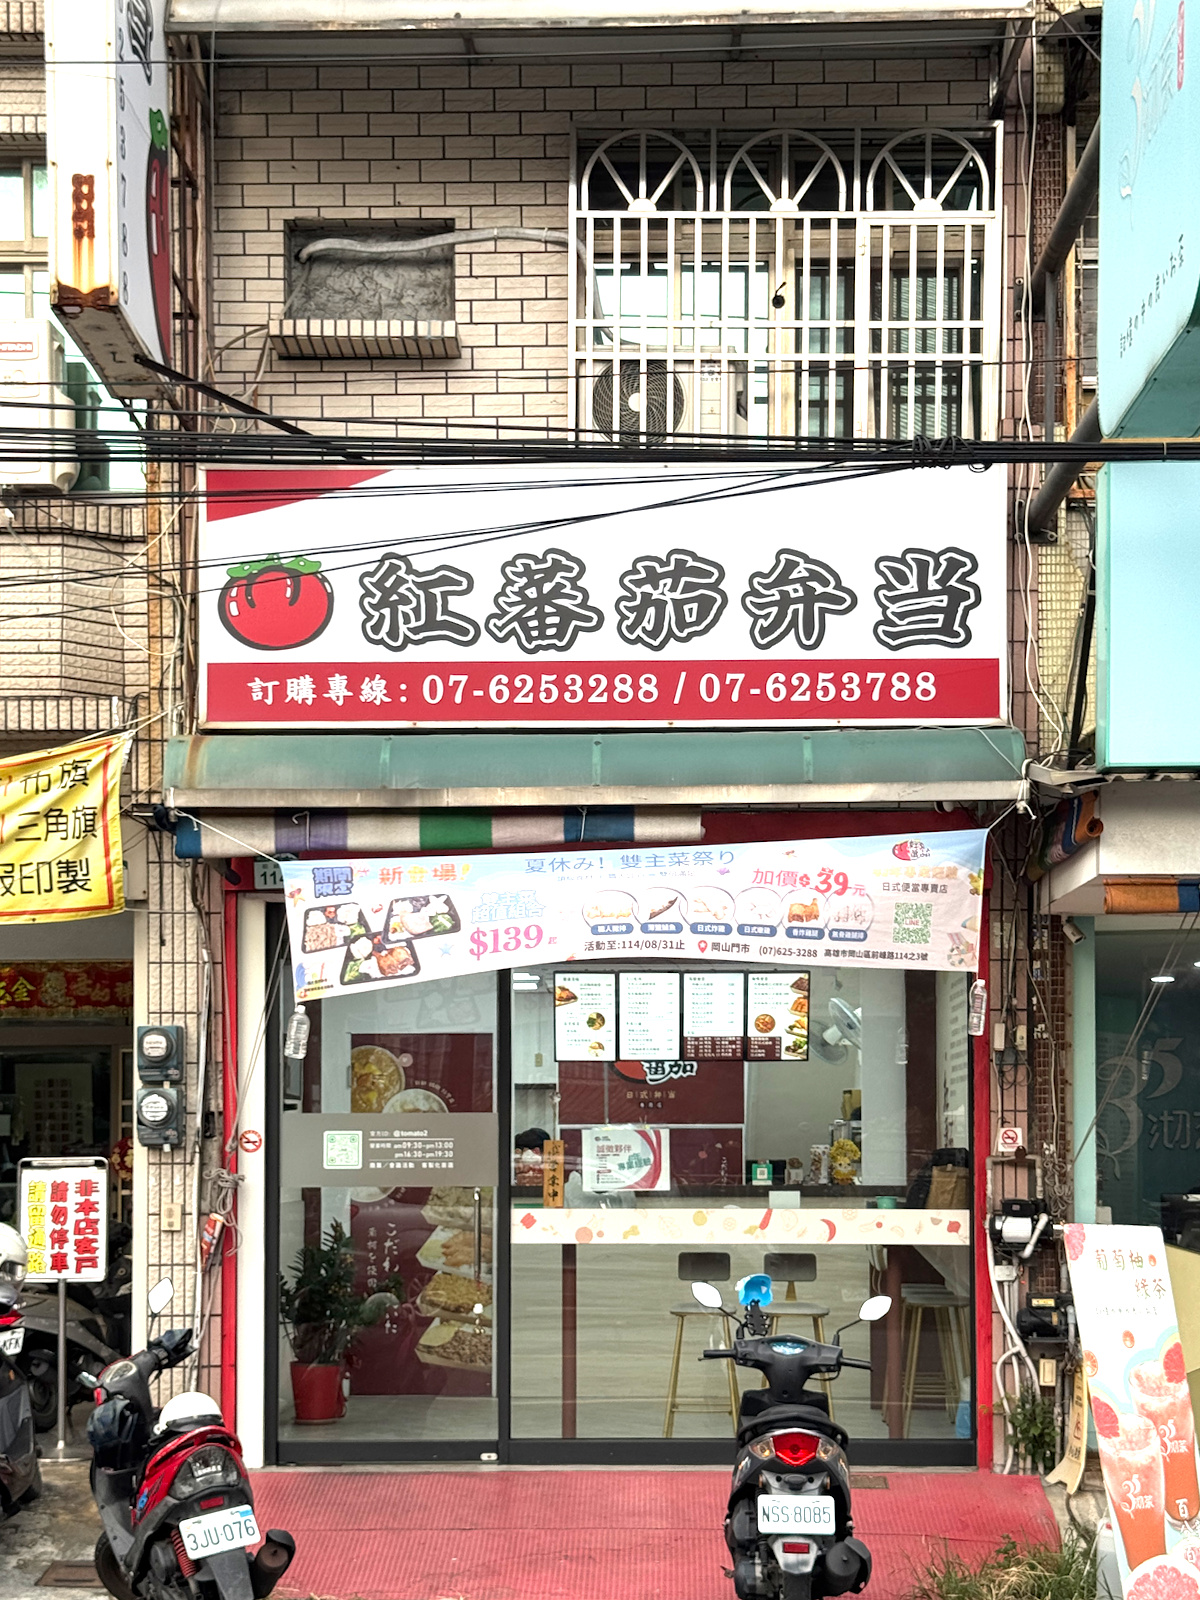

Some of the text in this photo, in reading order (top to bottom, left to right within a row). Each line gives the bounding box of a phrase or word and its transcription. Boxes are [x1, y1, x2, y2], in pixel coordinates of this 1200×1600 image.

[362, 547, 981, 652] 紅蕃茄弁当
[421, 672, 660, 705] 07-6253288
[698, 672, 937, 702] 07-6253788
[15, 805, 98, 841] 三角旗
[620, 850, 735, 869] 雙主菜祭り
[882, 882, 948, 894] 日式便當專賣店
[469, 926, 544, 961] $139
[759, 945, 818, 958] (07)625-3288
[50, 1180, 70, 1274] 請勿停車
[73, 1179, 100, 1274] 非本店客戶
